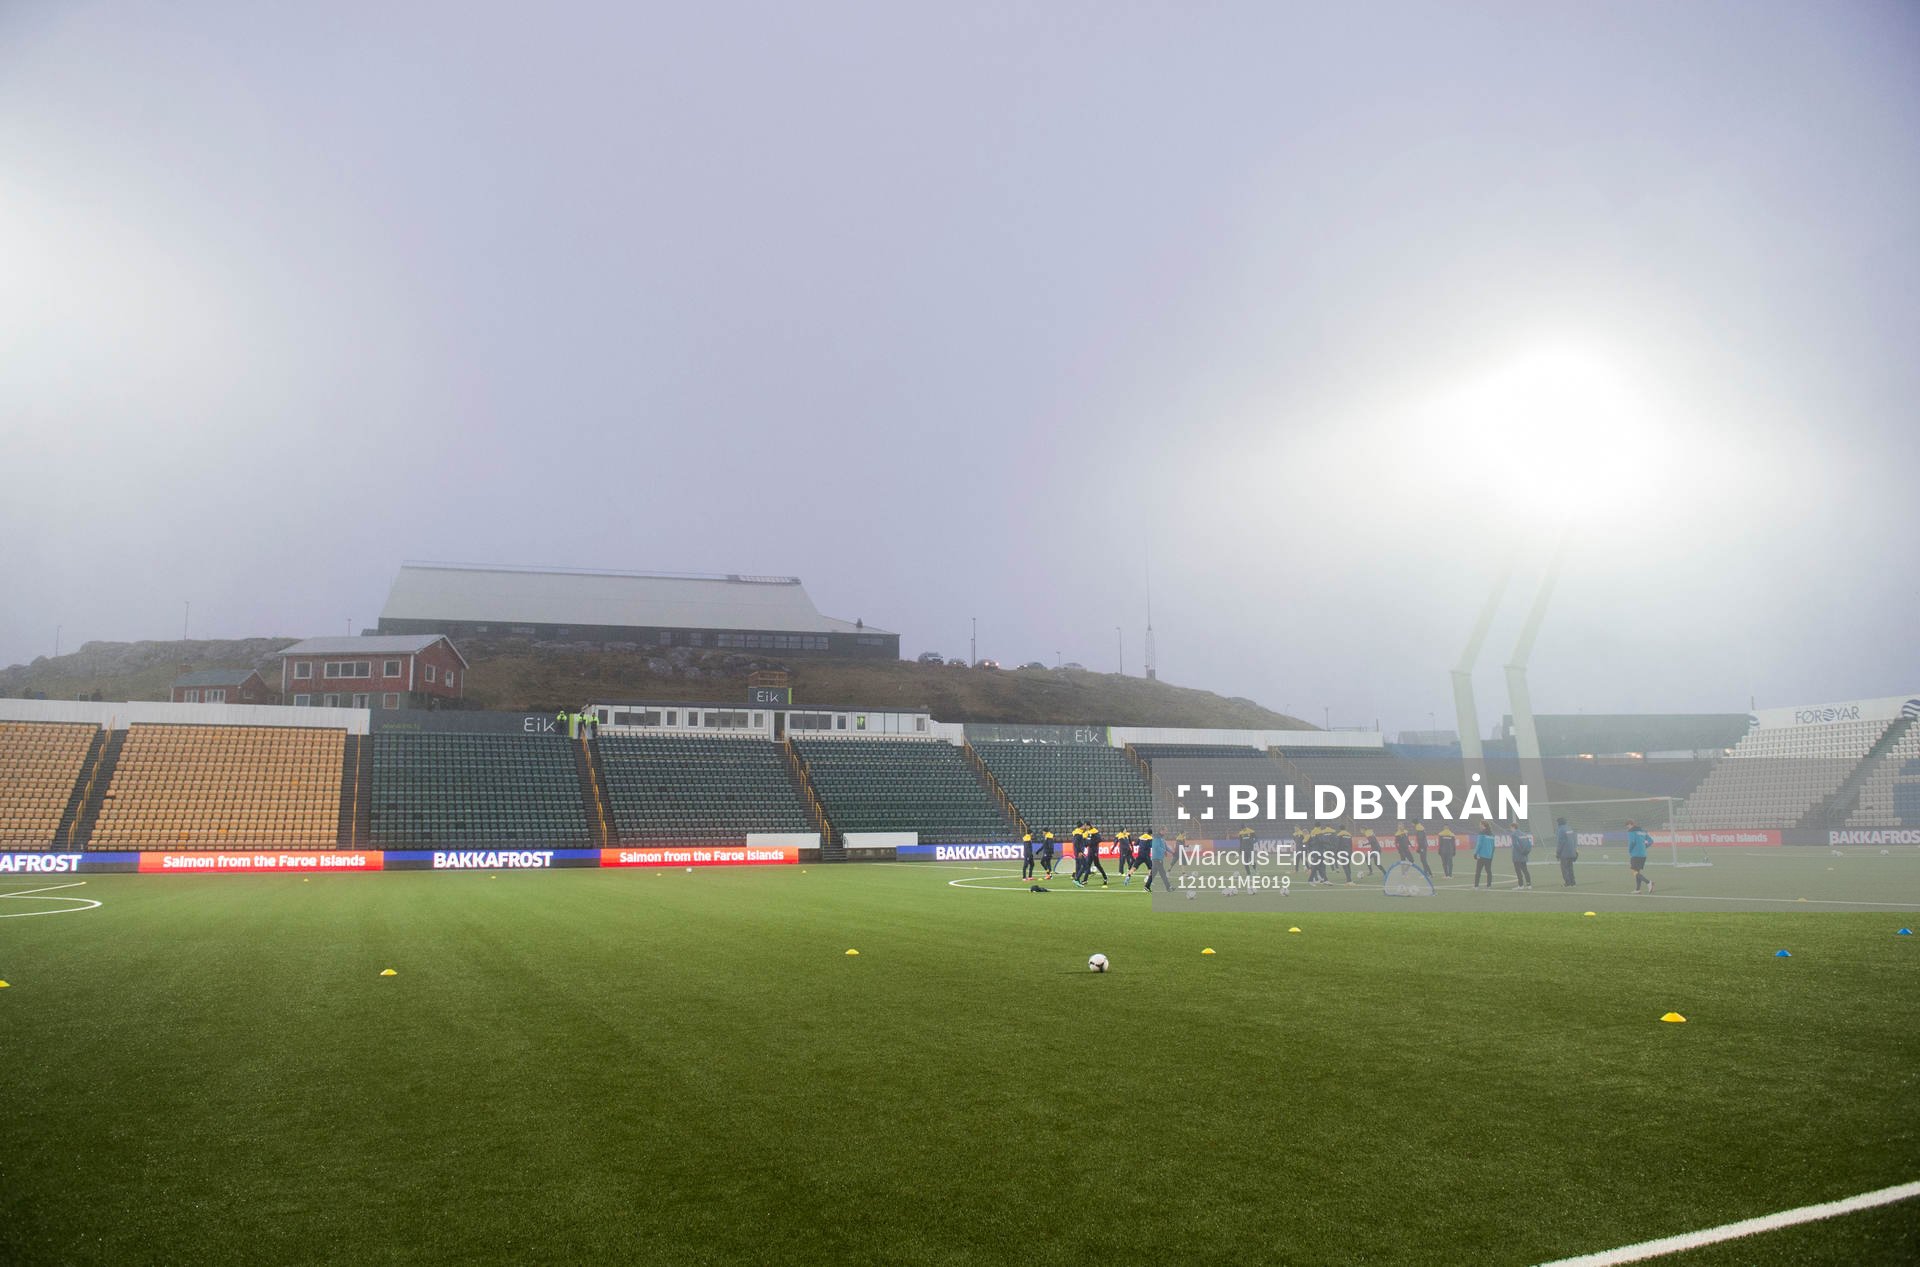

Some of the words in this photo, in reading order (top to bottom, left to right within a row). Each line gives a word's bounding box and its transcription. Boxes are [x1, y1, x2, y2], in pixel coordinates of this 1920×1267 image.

[757, 690, 779, 702] Eik
[523, 717, 556, 732] Eik
[1075, 728, 1099, 742] Eik
[1737, 832, 1768, 843] Islands
[163, 855, 215, 868] Salmon
[218, 855, 251, 867] from
[254, 855, 276, 867] the
[279, 855, 317, 867] Faroe
[320, 854, 366, 867] Islands
[433, 851, 553, 868] BAKKAFROST
[620, 851, 661, 863] Salmon
[664, 851, 690, 862] from
[693, 850, 711, 861] the
[714, 850, 744, 861] Faroe
[747, 849, 784, 861] Islands
